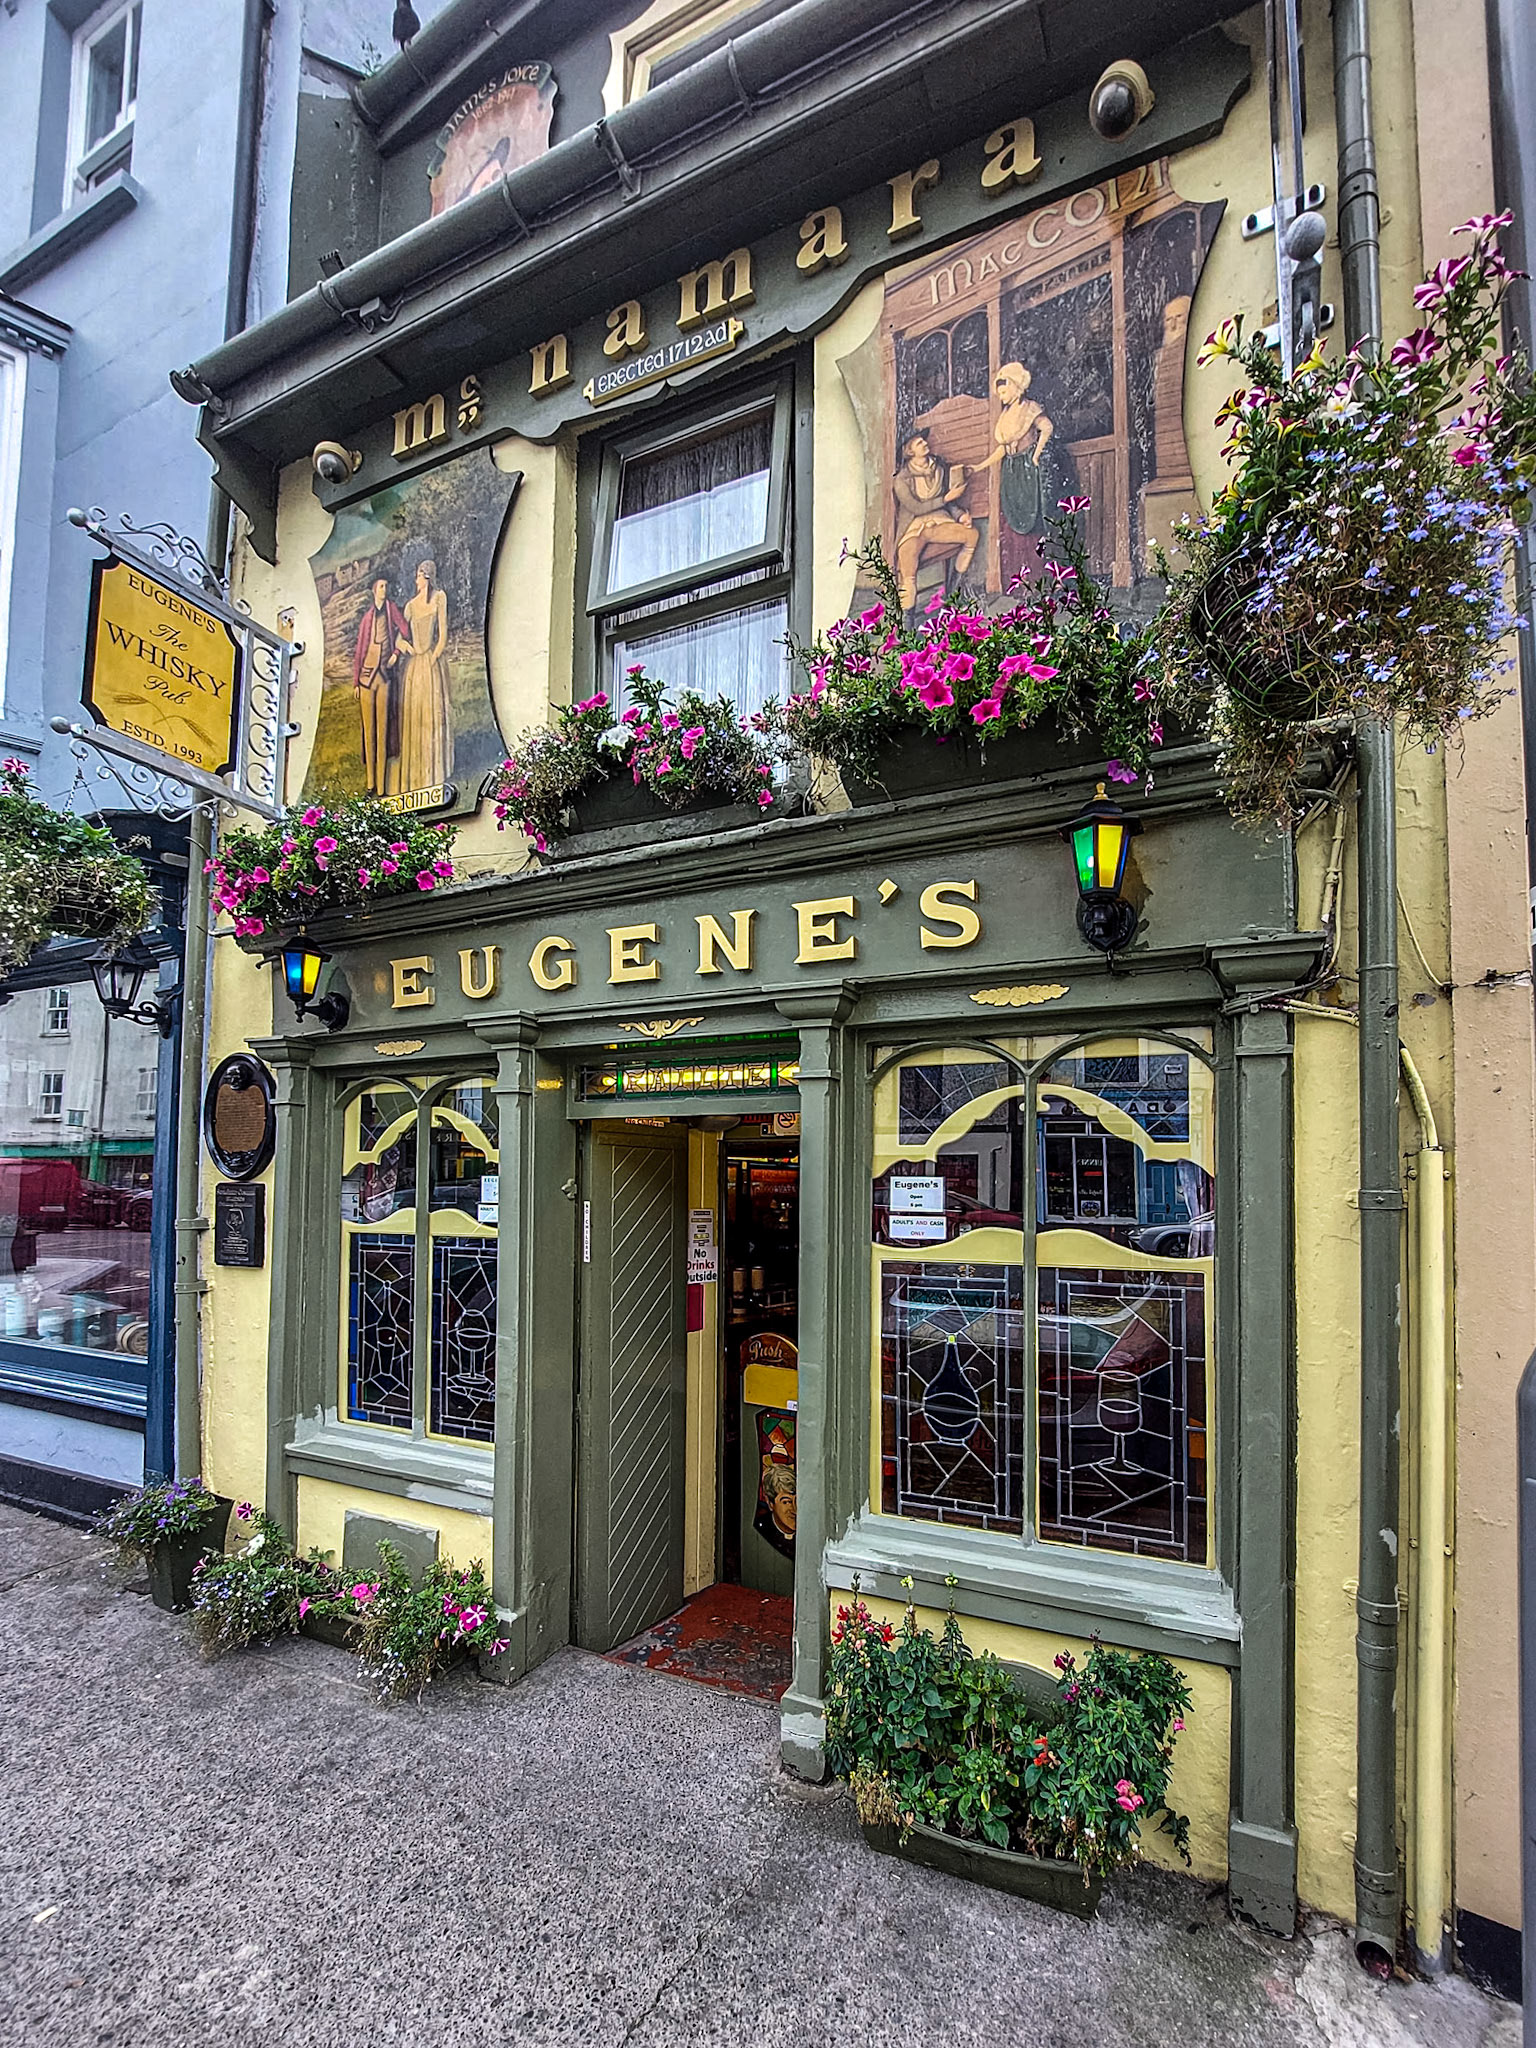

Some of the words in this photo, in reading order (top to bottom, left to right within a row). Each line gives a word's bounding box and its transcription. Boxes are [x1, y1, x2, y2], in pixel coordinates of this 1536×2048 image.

[128, 573, 216, 634] EUGENE'S
[149, 623, 190, 652] The
[103, 618, 227, 699] WHISKY
[143, 675, 191, 705] Pub
[121, 719, 168, 750] ESTD.
[173, 742, 203, 764] 1993
[389, 878, 983, 1010] EUGENE'S
[894, 1180, 939, 1190] Eugene's
[693, 1248, 707, 1258] No
[749, 1339, 783, 1361] Push
